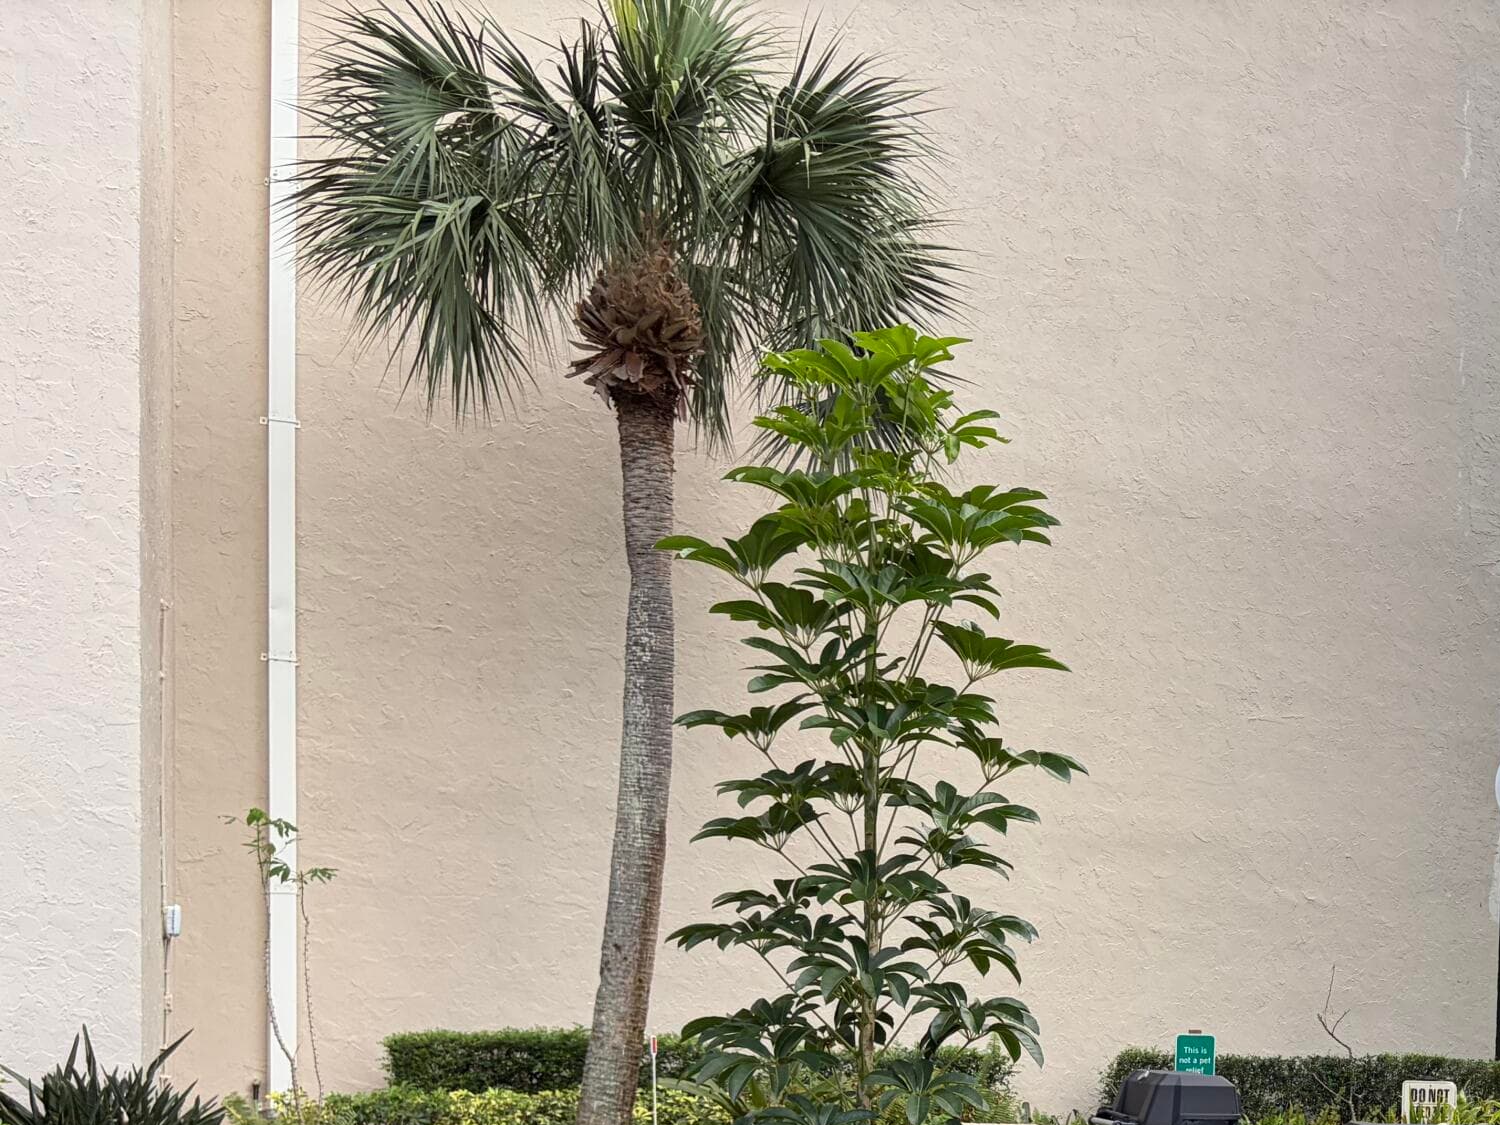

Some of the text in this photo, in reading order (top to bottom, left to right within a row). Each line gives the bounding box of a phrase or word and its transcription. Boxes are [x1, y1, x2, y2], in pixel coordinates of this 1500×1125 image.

[1183, 1046, 1207, 1054] This is
[1199, 1057, 1211, 1065] pet
[1411, 1088, 1450, 1103] DO NOT
